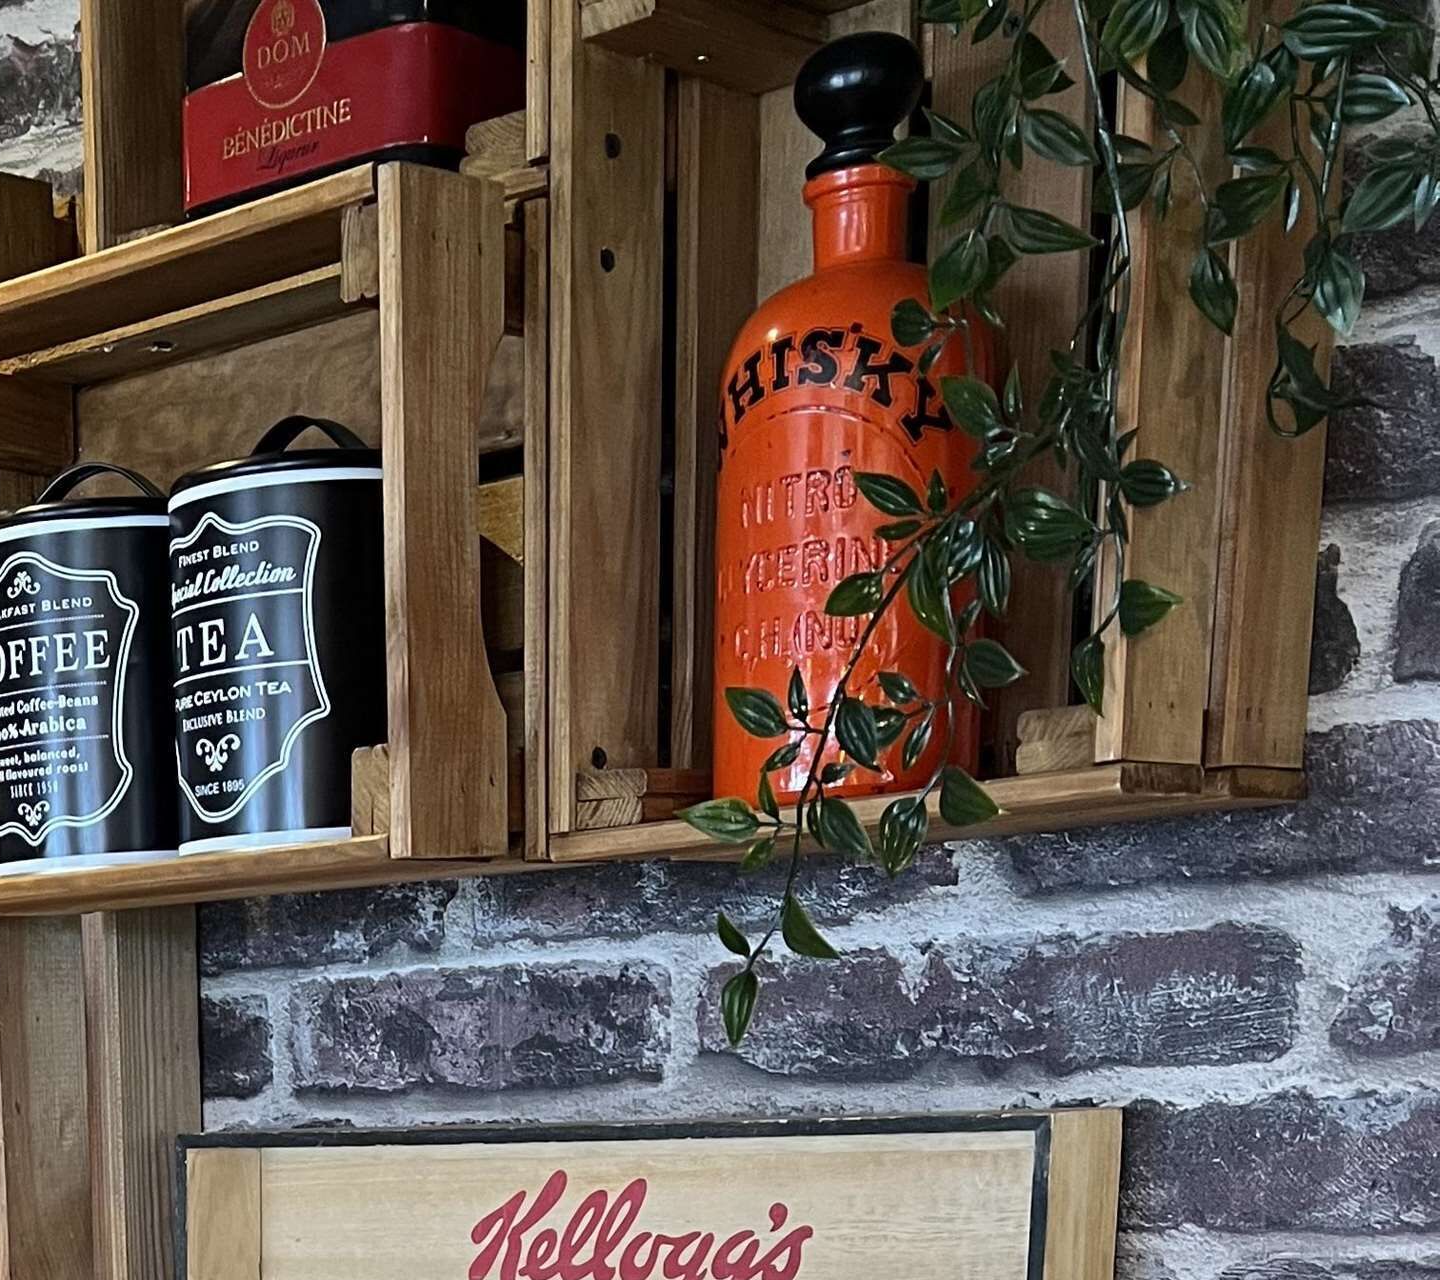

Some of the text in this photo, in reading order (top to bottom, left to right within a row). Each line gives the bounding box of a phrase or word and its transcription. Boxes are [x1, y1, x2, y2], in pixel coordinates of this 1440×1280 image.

[258, 32, 310, 69] DOM
[222, 98, 352, 160] BÉNÉDICTINE
[718, 327, 954, 472] HISKY
[178, 540, 260, 568] FINEST BLEND
[203, 561, 297, 594] Collection
[41, 597, 93, 612] BLEND
[177, 612, 274, 672] TEA
[194, 685, 252, 706] CEYLON
[255, 681, 292, 695] TEA
[19, 716, 87, 736] Arabica
[182, 707, 266, 733] EXCLUSIVE BLEND
[23, 746, 80, 763] balanced,
[56, 761, 89, 774] roast
[194, 778, 245, 797] SINCE 1895
